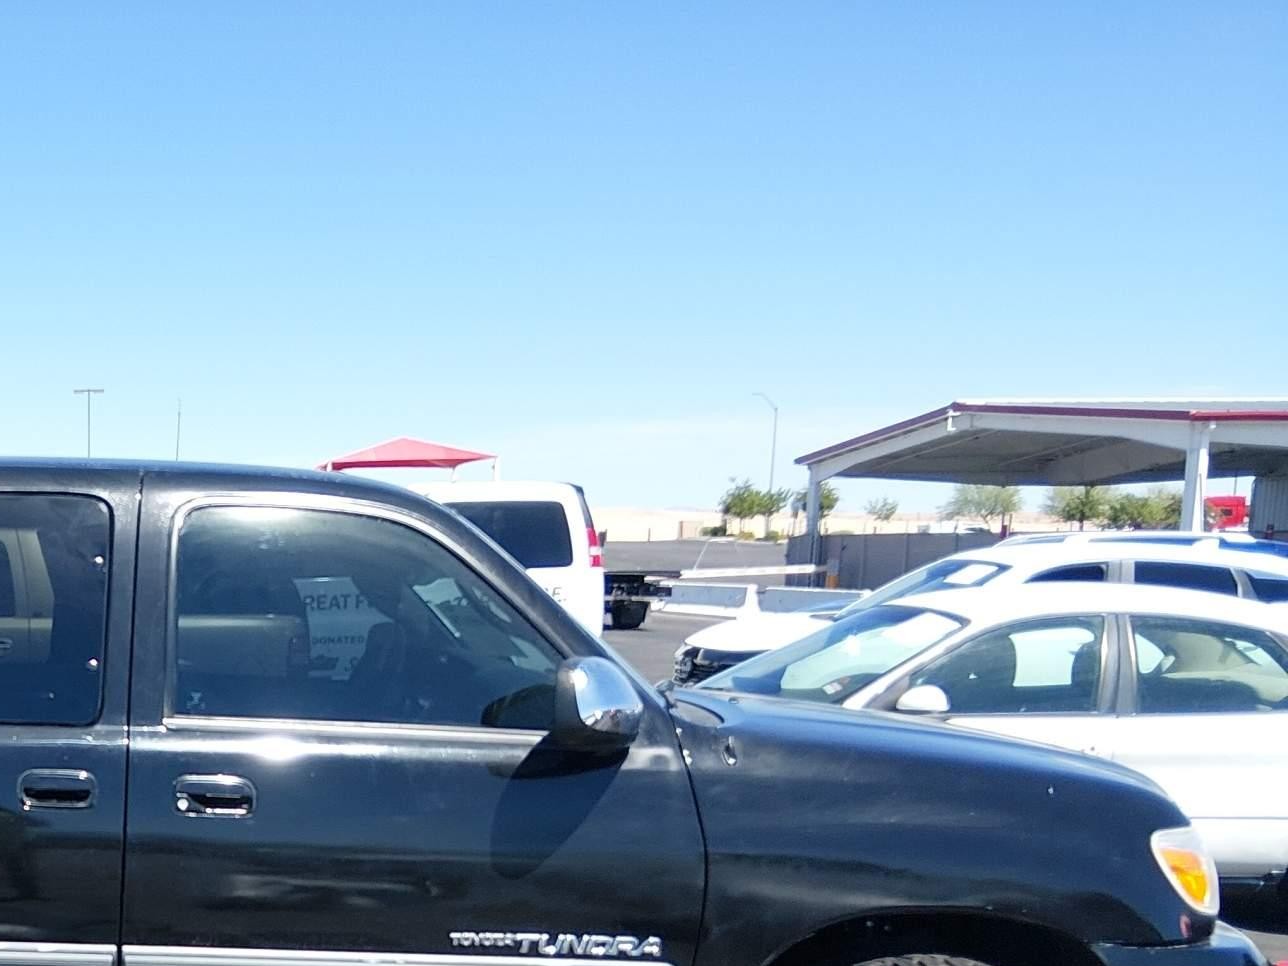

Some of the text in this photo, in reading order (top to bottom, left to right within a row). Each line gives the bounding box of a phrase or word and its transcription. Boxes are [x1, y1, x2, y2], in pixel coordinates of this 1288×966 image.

[312, 635, 365, 645] DONATED
[449, 931, 661, 957] TOYOTA TUNDRA
